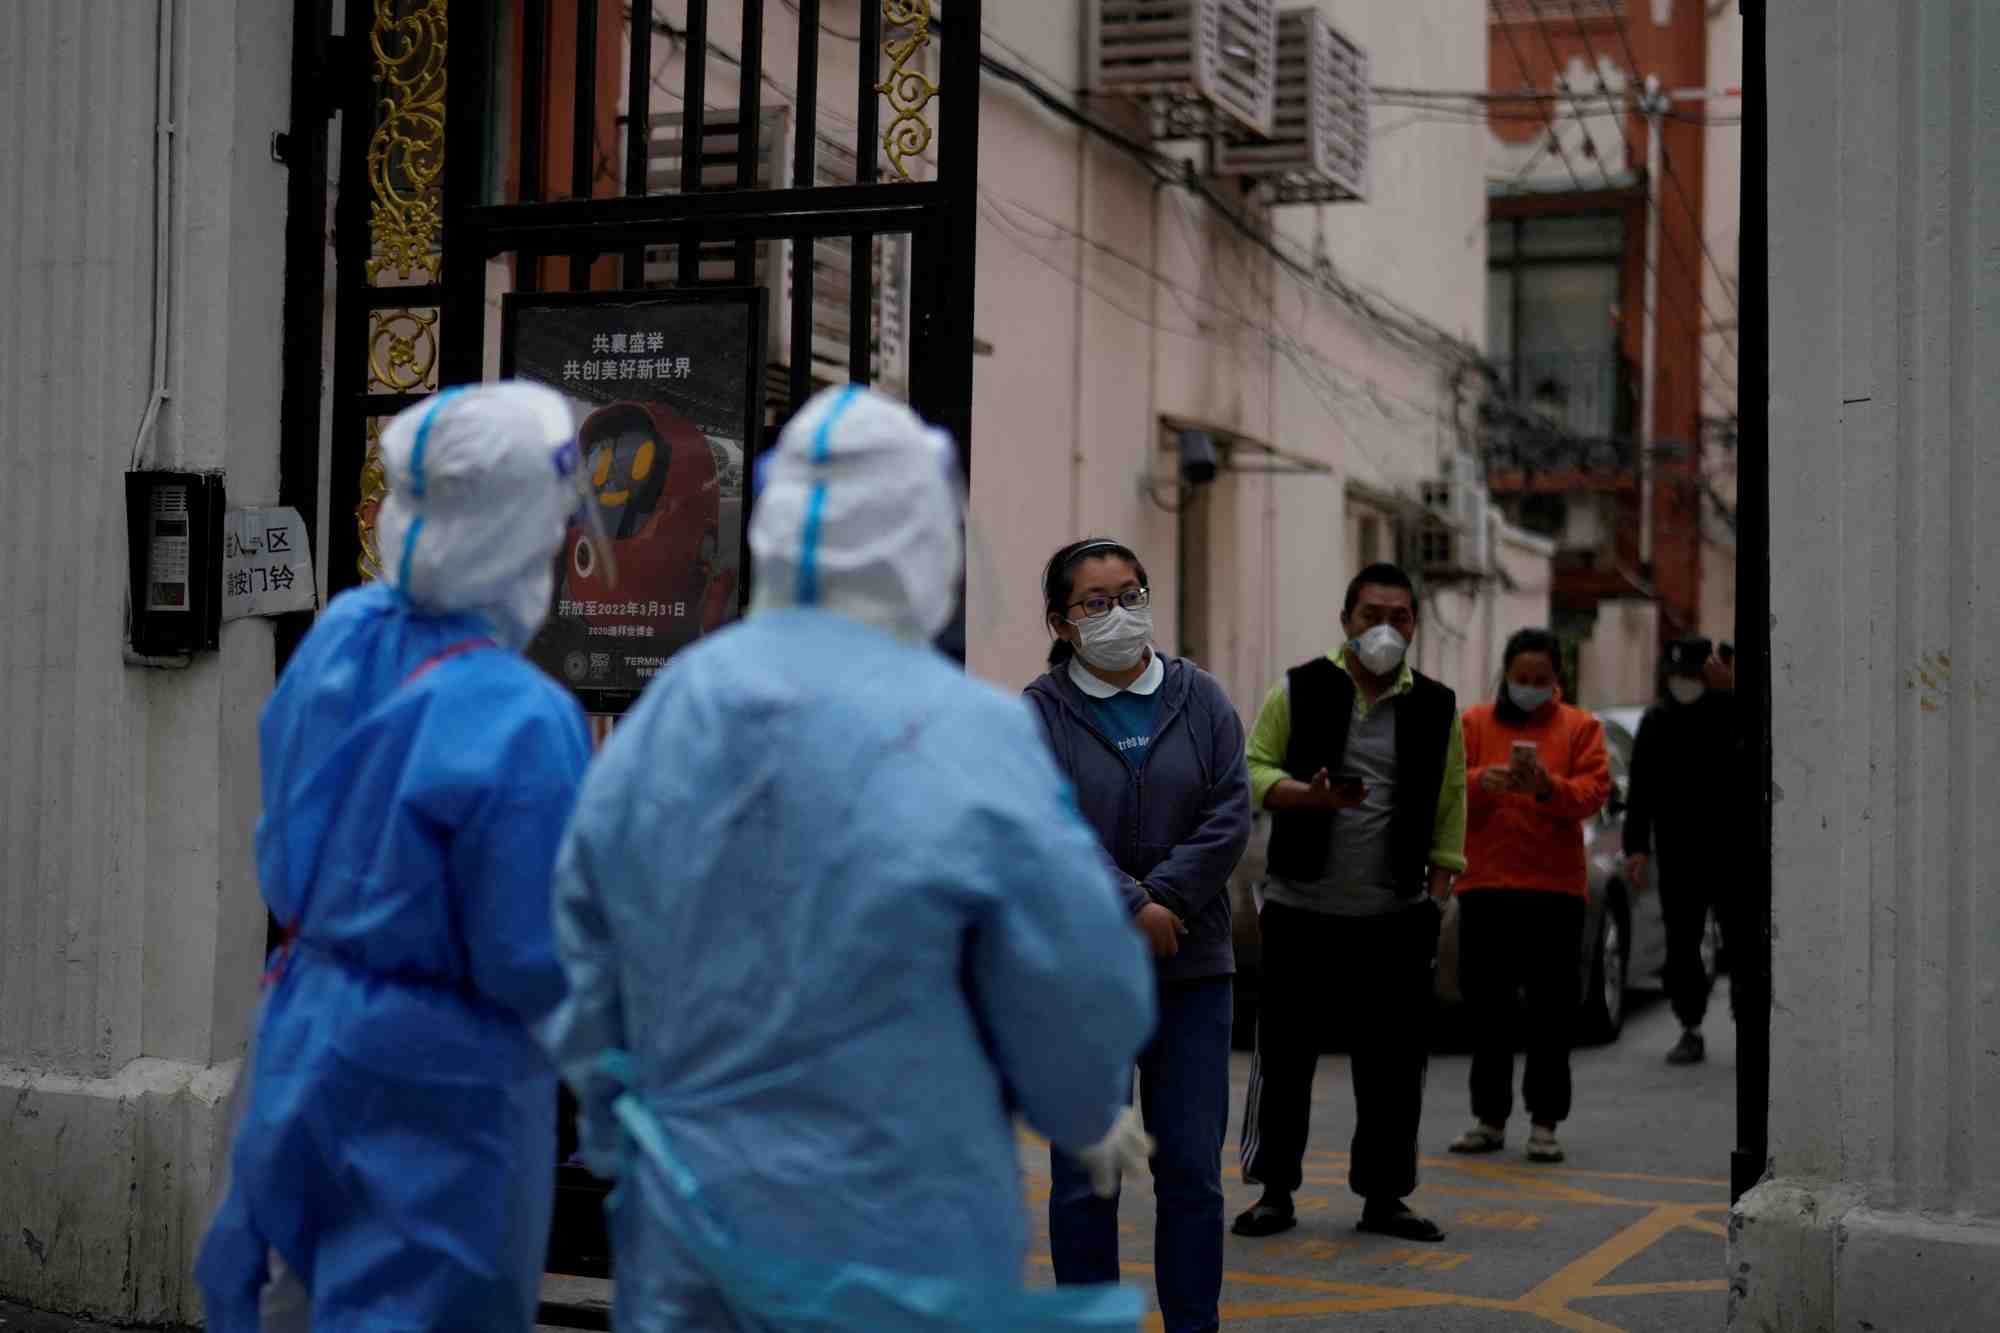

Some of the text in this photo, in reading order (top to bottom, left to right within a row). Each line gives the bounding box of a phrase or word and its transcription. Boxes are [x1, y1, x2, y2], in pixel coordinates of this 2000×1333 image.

[592, 331, 665, 354] 共襄盛举
[563, 357, 691, 380] 共创美好新世界
[559, 600, 685, 617] 开放至2022年3月31日
